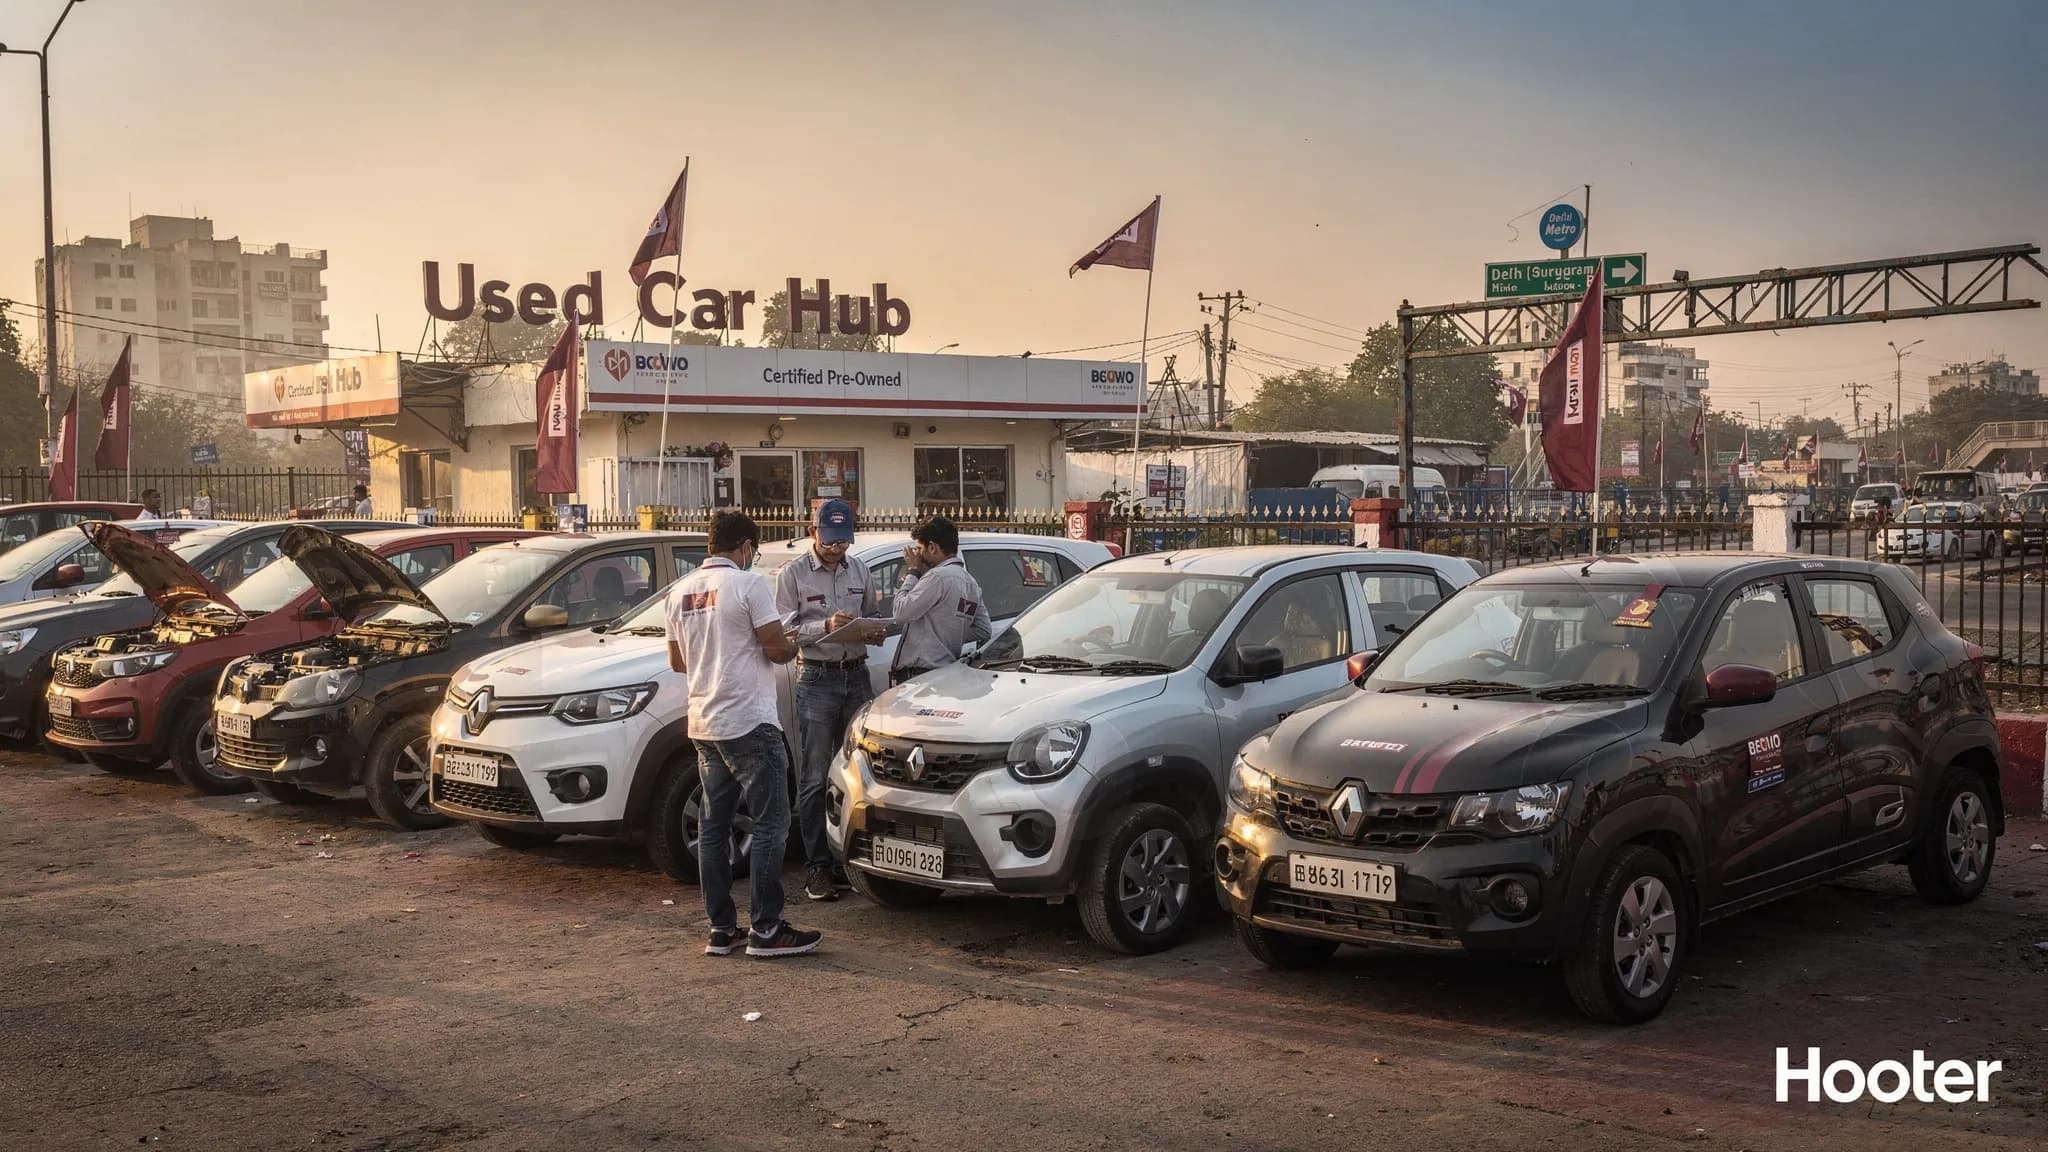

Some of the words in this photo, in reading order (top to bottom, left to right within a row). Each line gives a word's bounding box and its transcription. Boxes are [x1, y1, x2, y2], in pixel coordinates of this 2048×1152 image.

[1545, 223, 1576, 236] Metro
[422, 260, 604, 326] Used
[637, 270, 756, 331] Car
[786, 277, 912, 337] Hub
[763, 367, 823, 385] Certified
[827, 369, 901, 387] Pre-Owned
